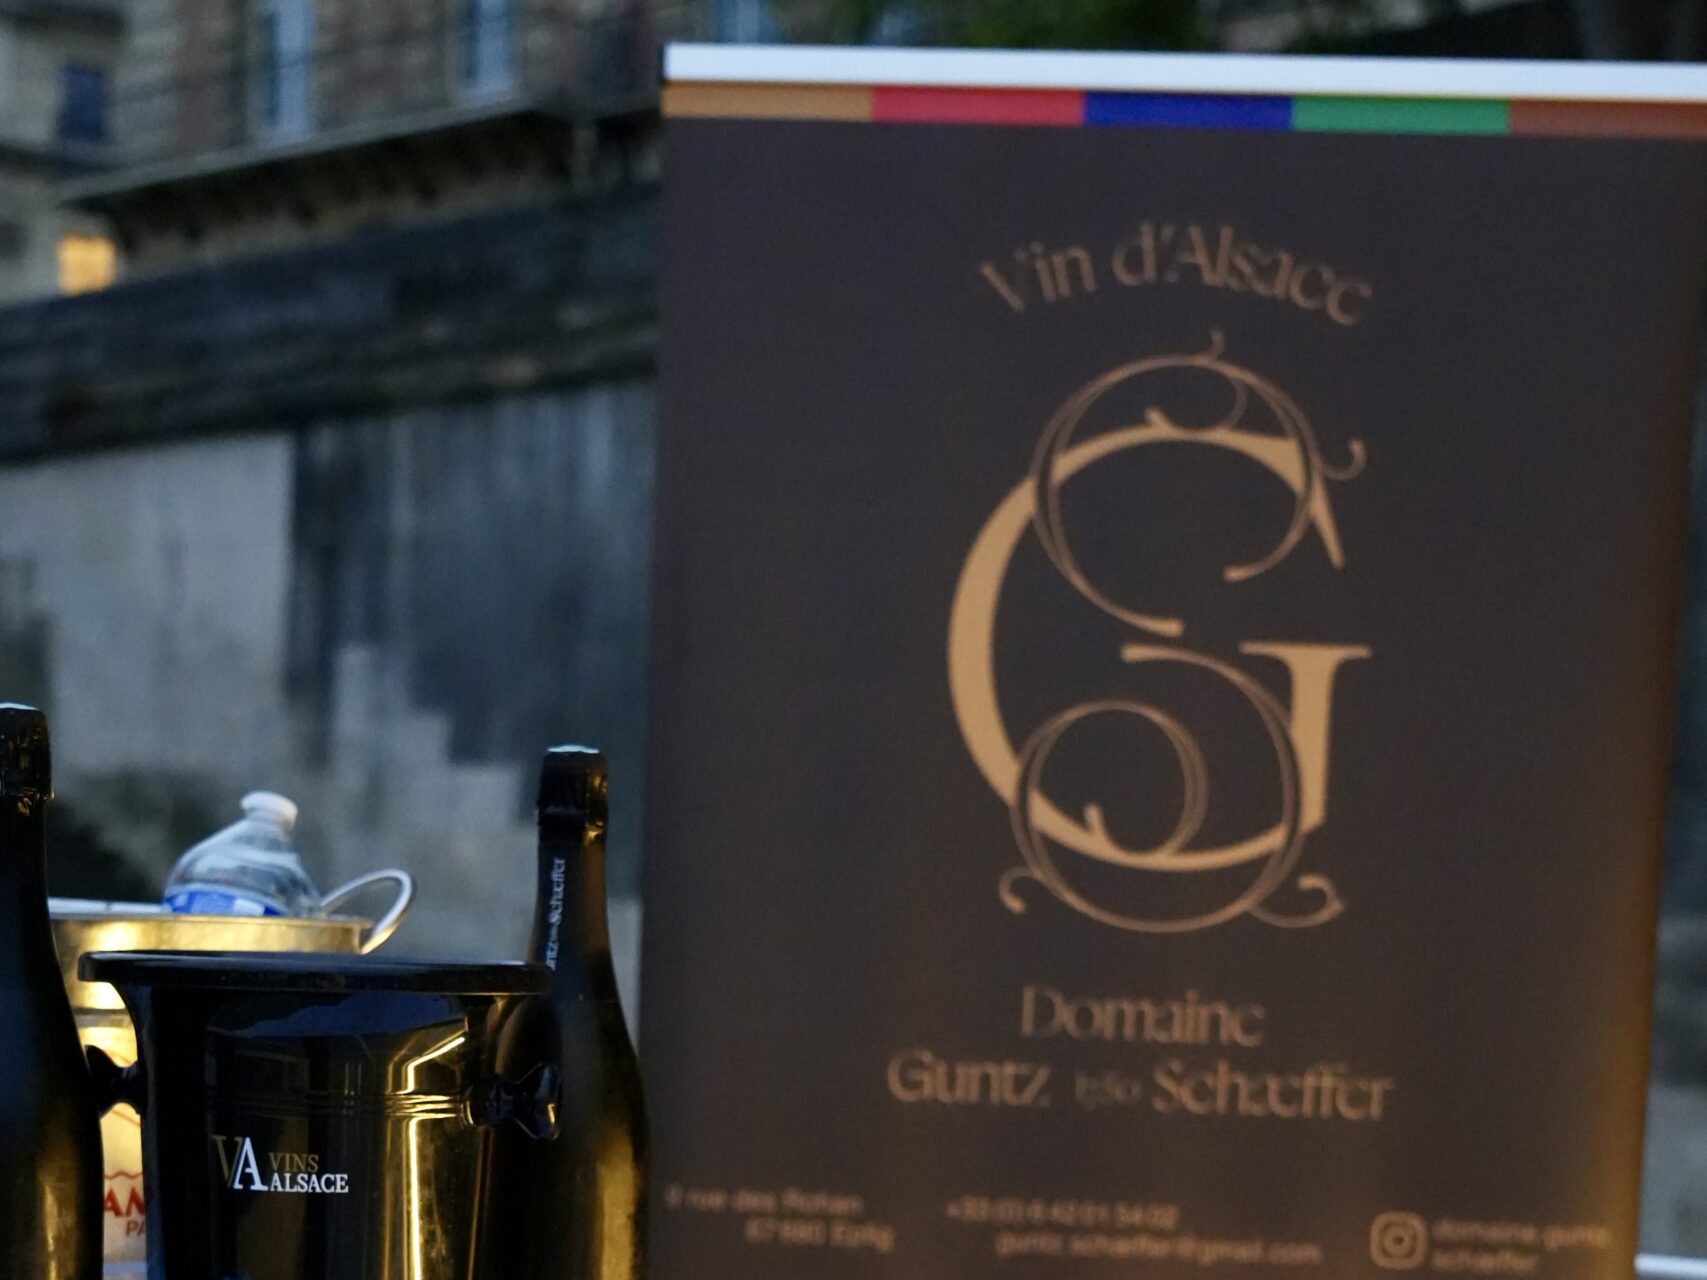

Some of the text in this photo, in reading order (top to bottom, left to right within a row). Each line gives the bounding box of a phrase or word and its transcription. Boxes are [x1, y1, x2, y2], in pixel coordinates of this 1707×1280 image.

[979, 221, 1373, 326] Vin d'Alsace
[1021, 985, 1265, 1047] Domaine
[886, 1048, 1051, 1107] Guntz
[1151, 1057, 1394, 1121] Schaeffer
[268, 1152, 320, 1173] VINS
[270, 1173, 350, 1194] ALSACE
